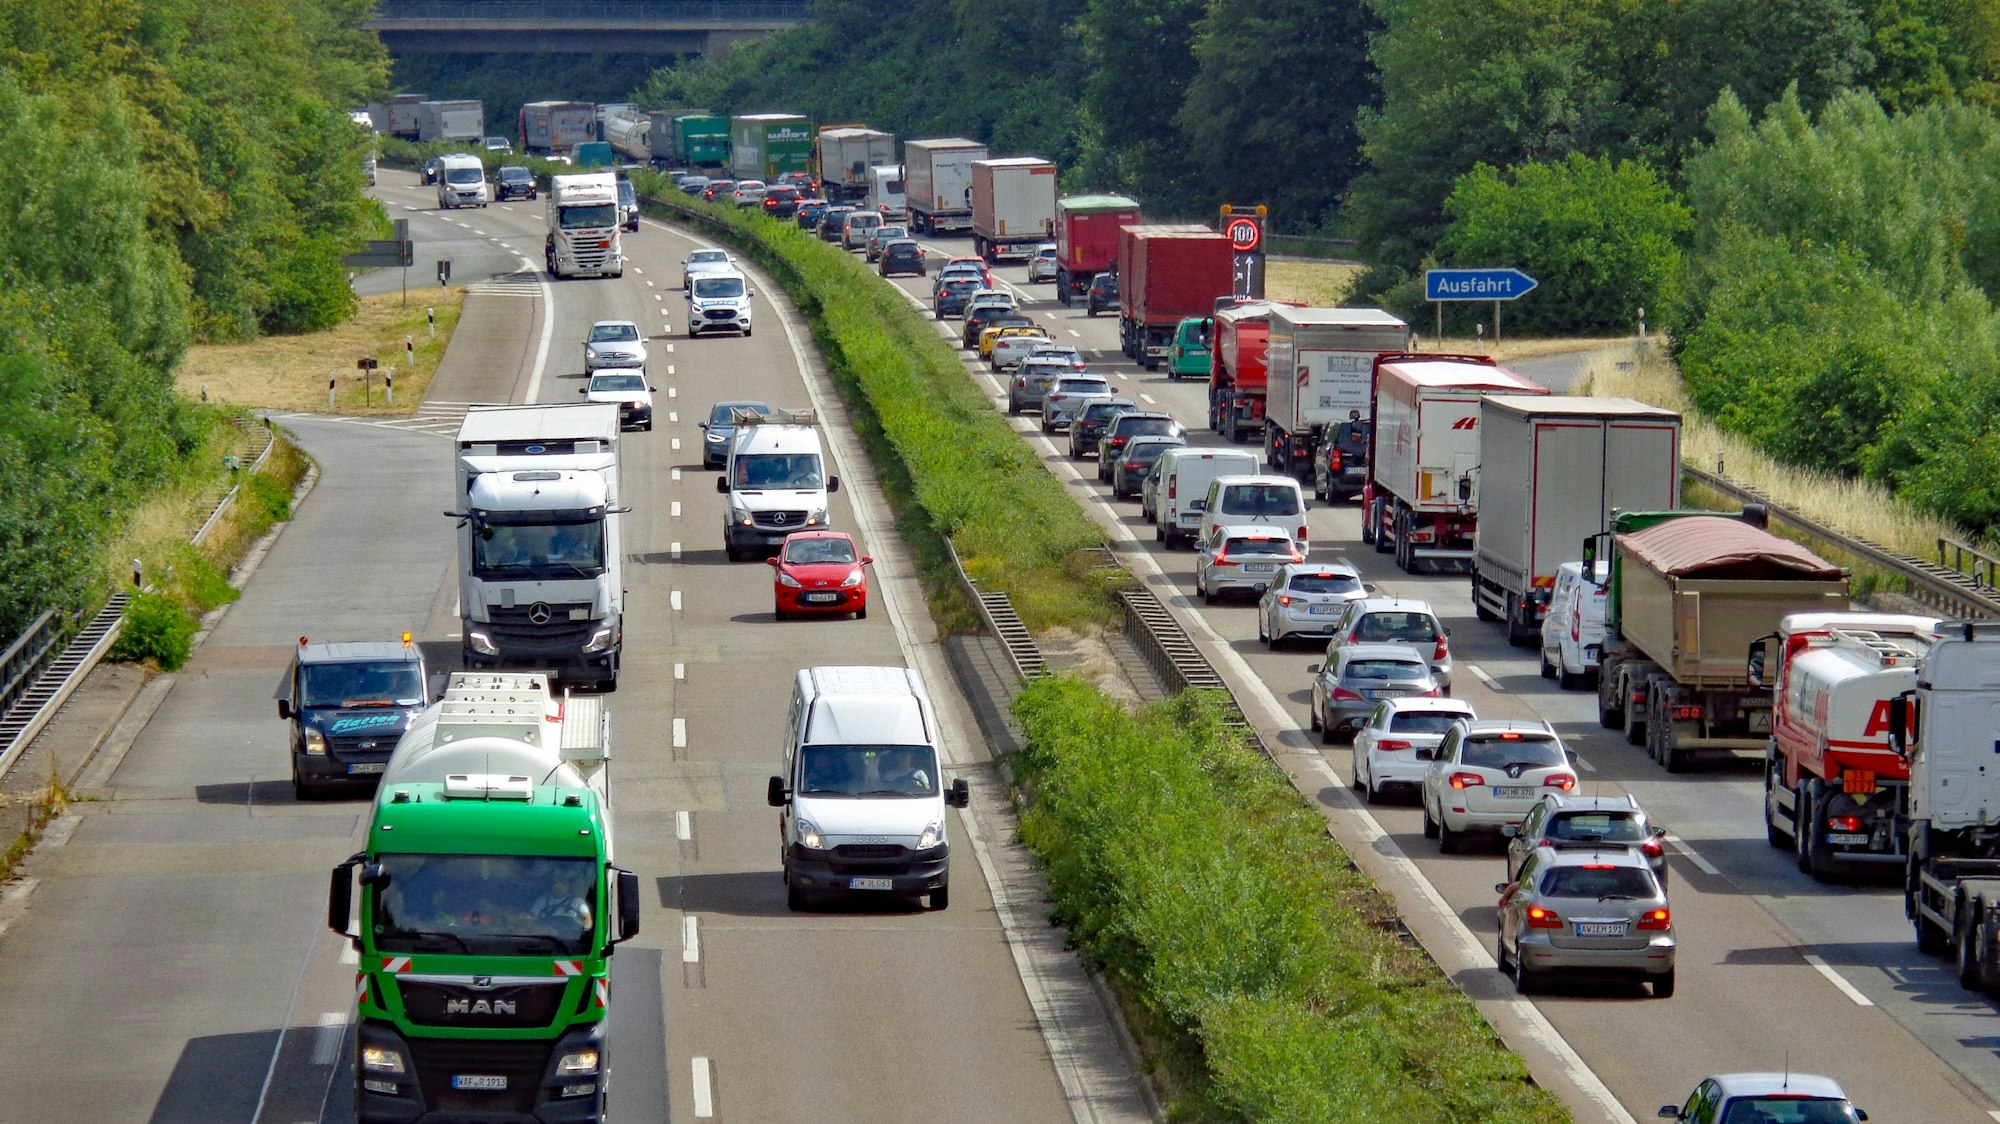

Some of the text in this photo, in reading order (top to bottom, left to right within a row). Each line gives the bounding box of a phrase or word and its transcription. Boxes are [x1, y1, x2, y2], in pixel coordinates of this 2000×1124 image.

[1233, 226, 1254, 241] 100
[1437, 277, 1512, 293] Ausfahrt
[1332, 358, 1355, 367] REWE
[1757, 715, 1770, 728] A
[447, 999, 516, 1014] MAN
[458, 1077, 473, 1087] WAF
